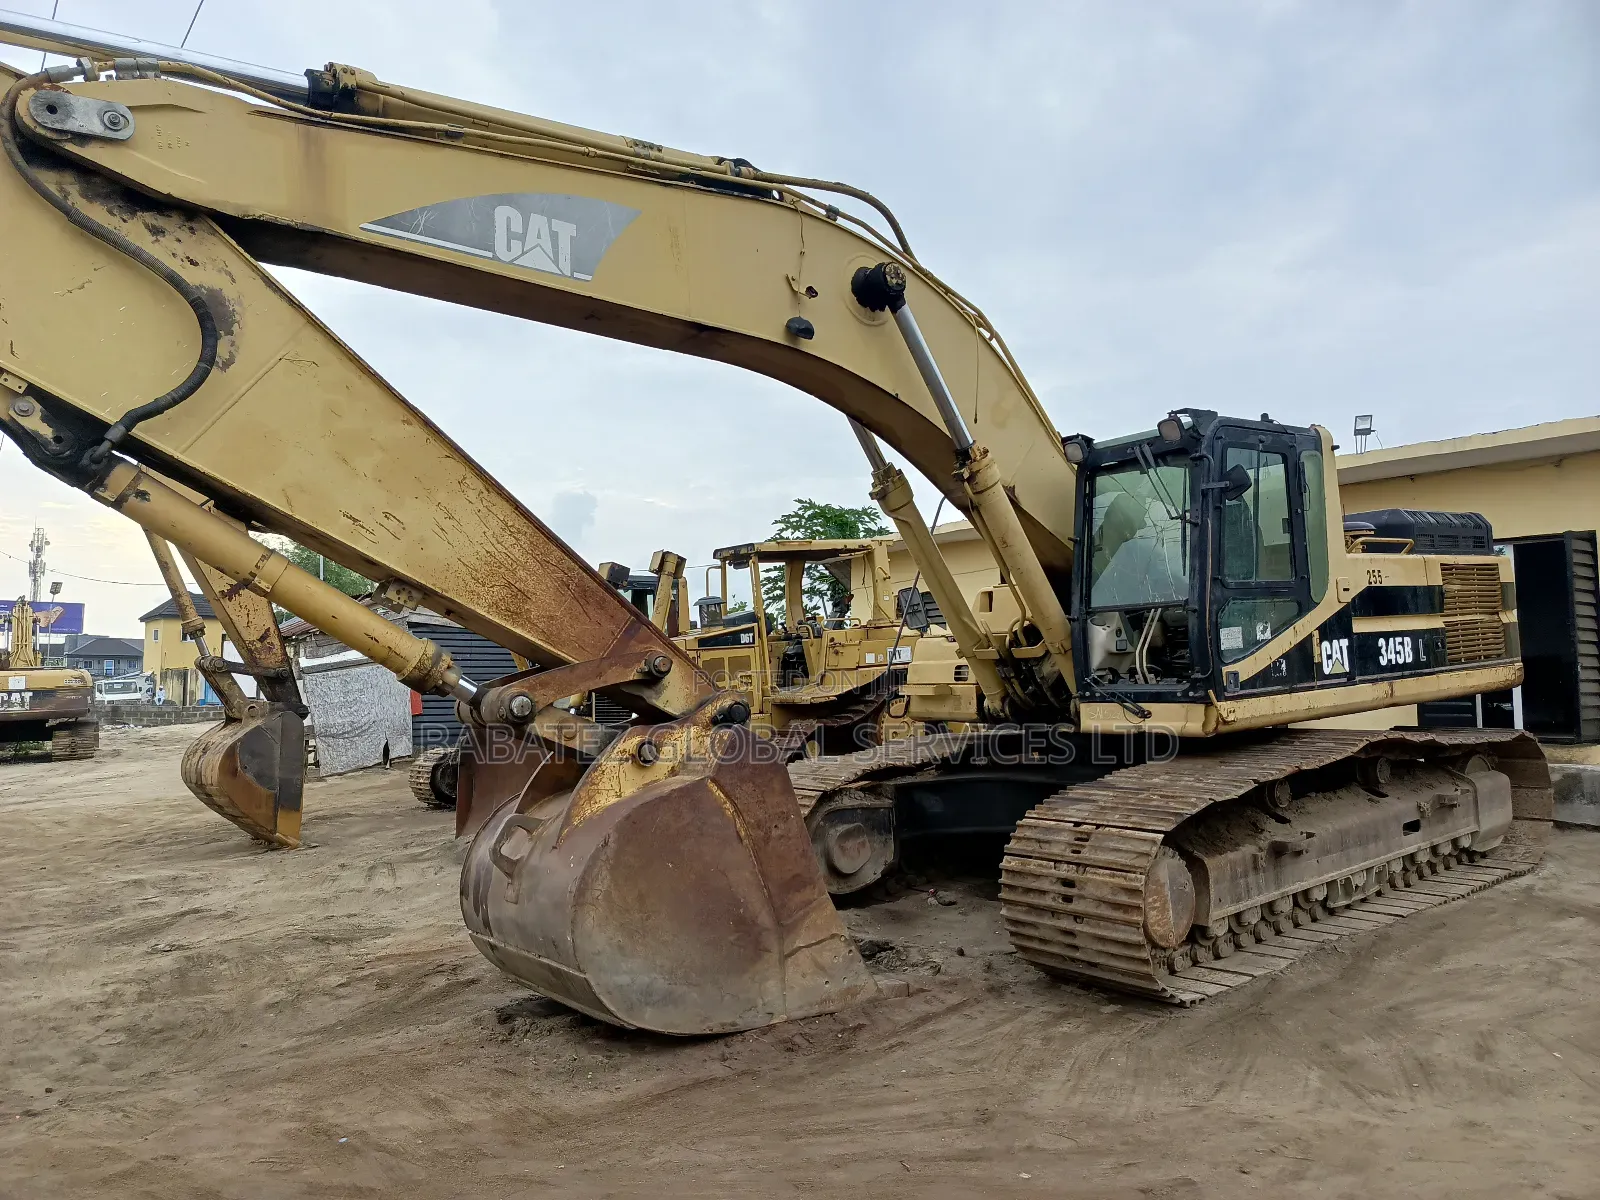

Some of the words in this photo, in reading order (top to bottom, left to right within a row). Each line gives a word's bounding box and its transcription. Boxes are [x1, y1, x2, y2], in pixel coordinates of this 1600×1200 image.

[494, 205, 577, 277] CAT
[1366, 569, 1383, 585] 255
[740, 633, 754, 644] D6T
[1378, 636, 1413, 666] 345B
[1321, 638, 1350, 675] CAT
